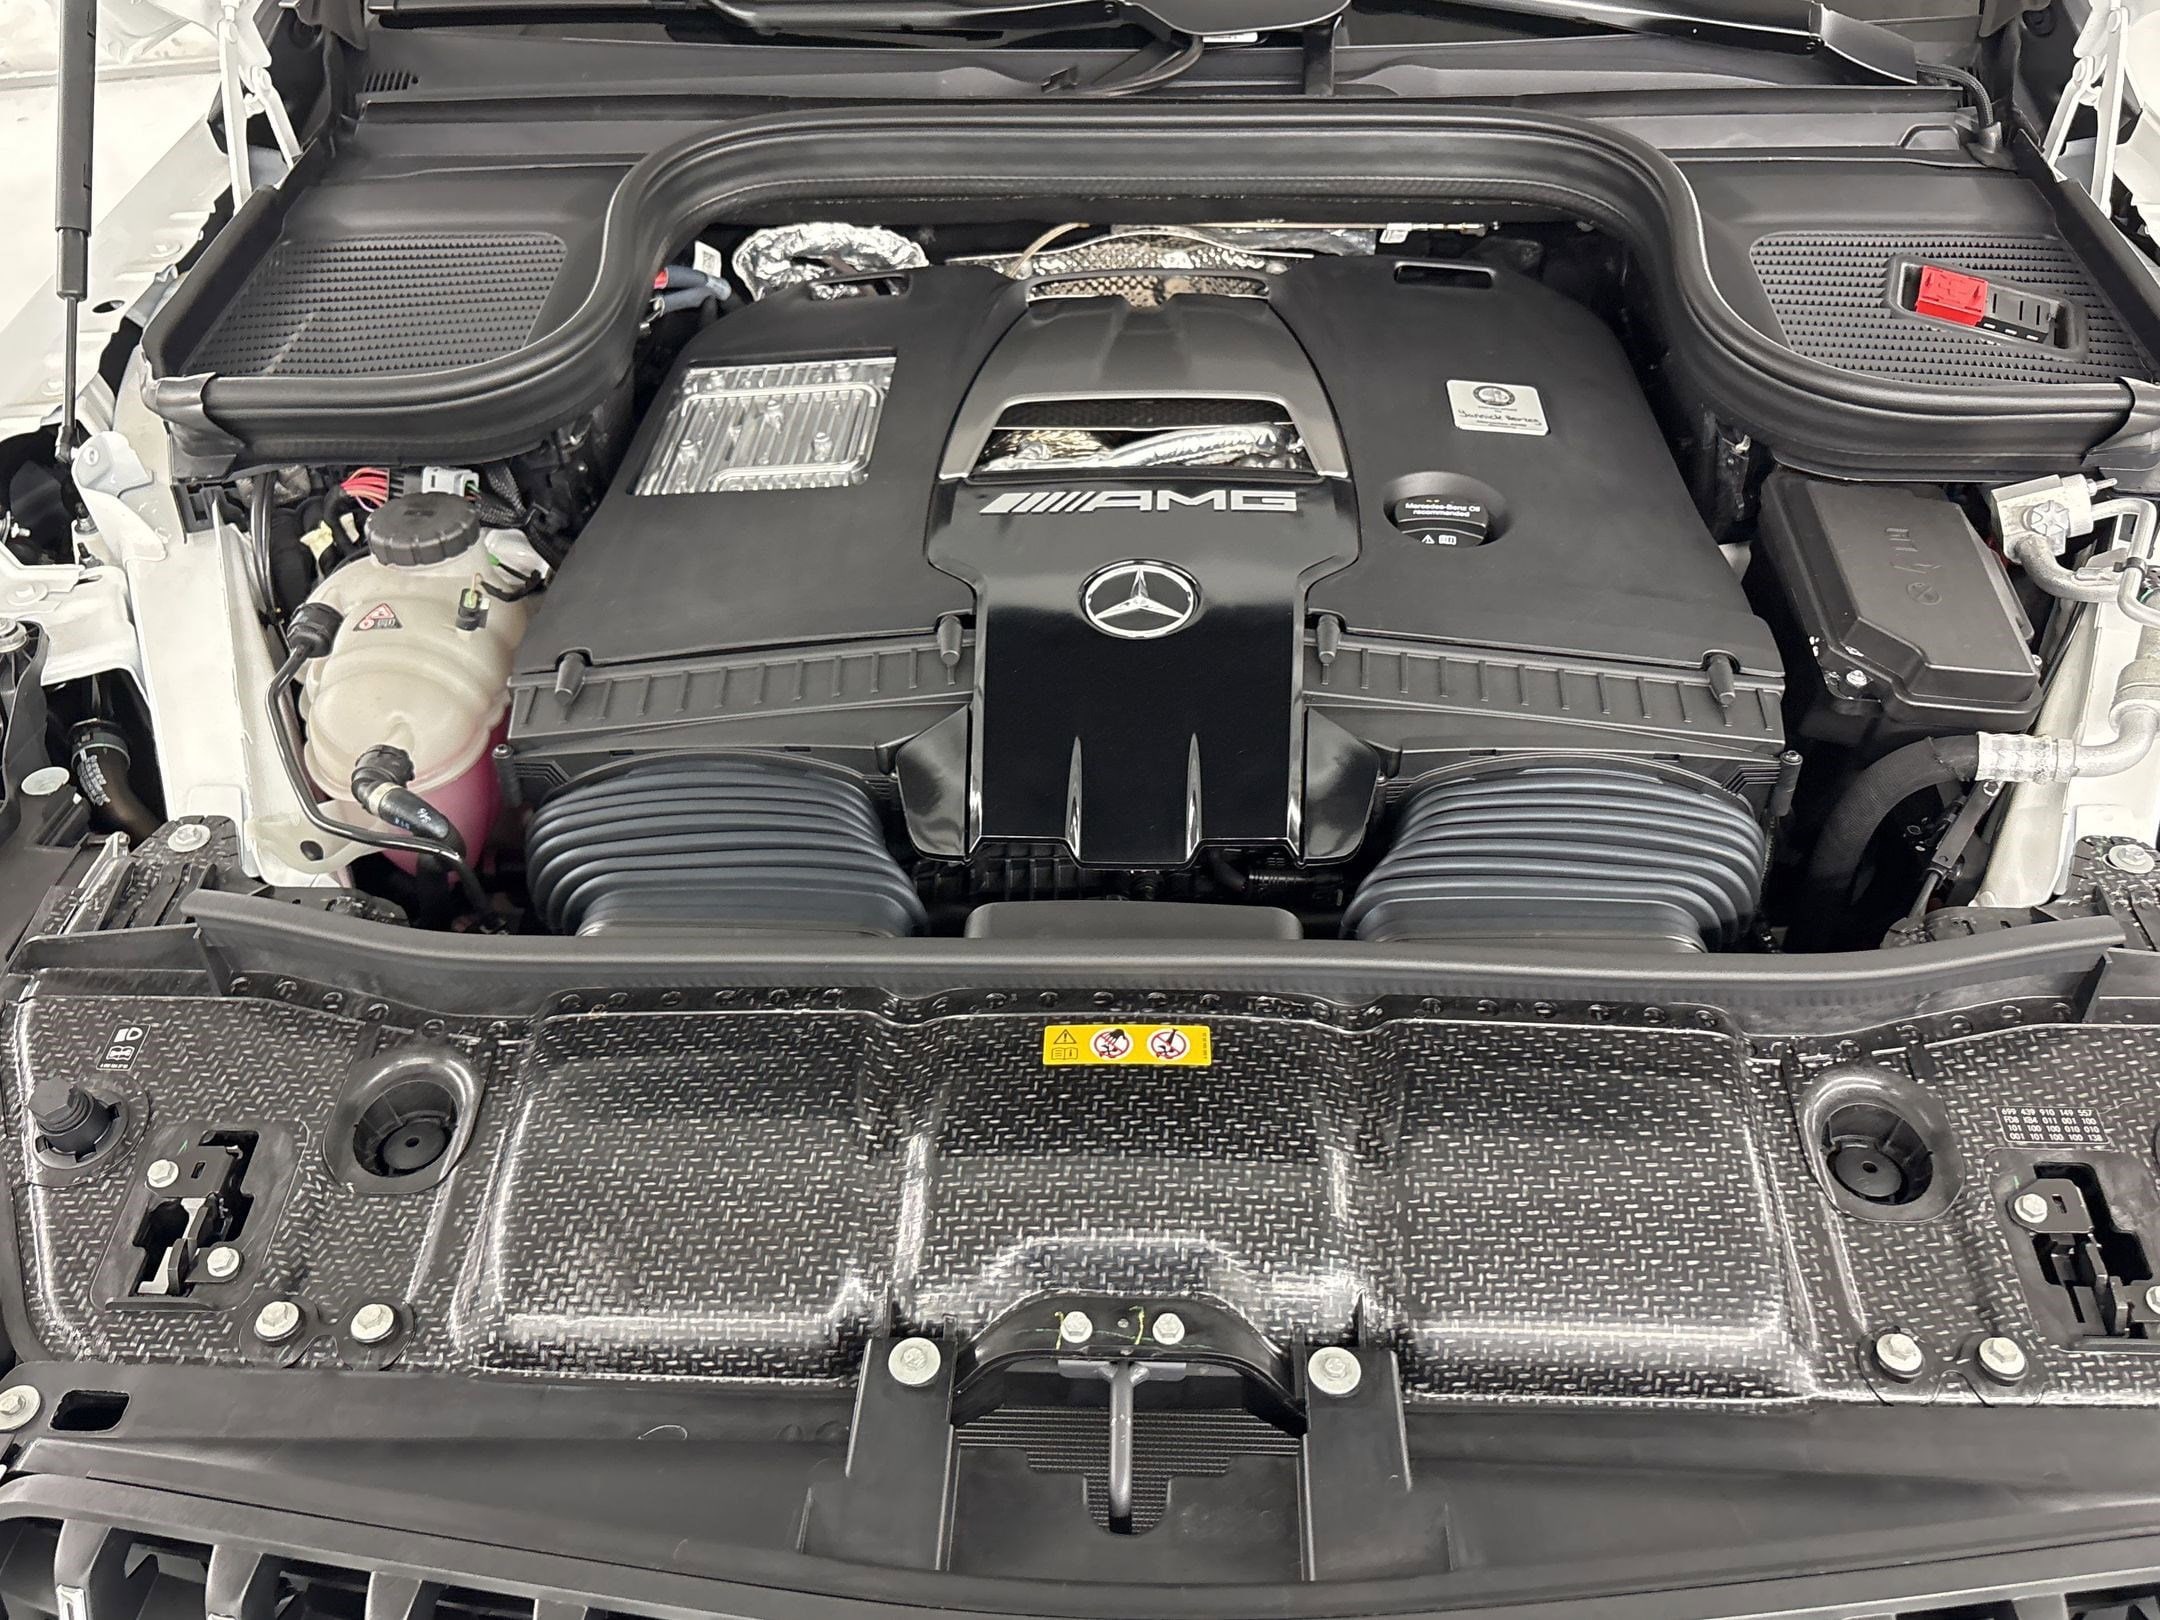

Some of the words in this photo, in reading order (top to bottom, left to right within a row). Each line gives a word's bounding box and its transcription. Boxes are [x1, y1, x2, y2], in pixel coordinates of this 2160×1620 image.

[1083, 489, 1298, 512] AMG
[1405, 502, 1468, 511] Mercedes-Benz
[1412, 509, 1471, 518] recommended
[2062, 1117, 2076, 1125] 001
[2046, 1125, 2060, 1133] 100
[2064, 1125, 2080, 1133] 010
[2049, 1133, 2064, 1141] 100
